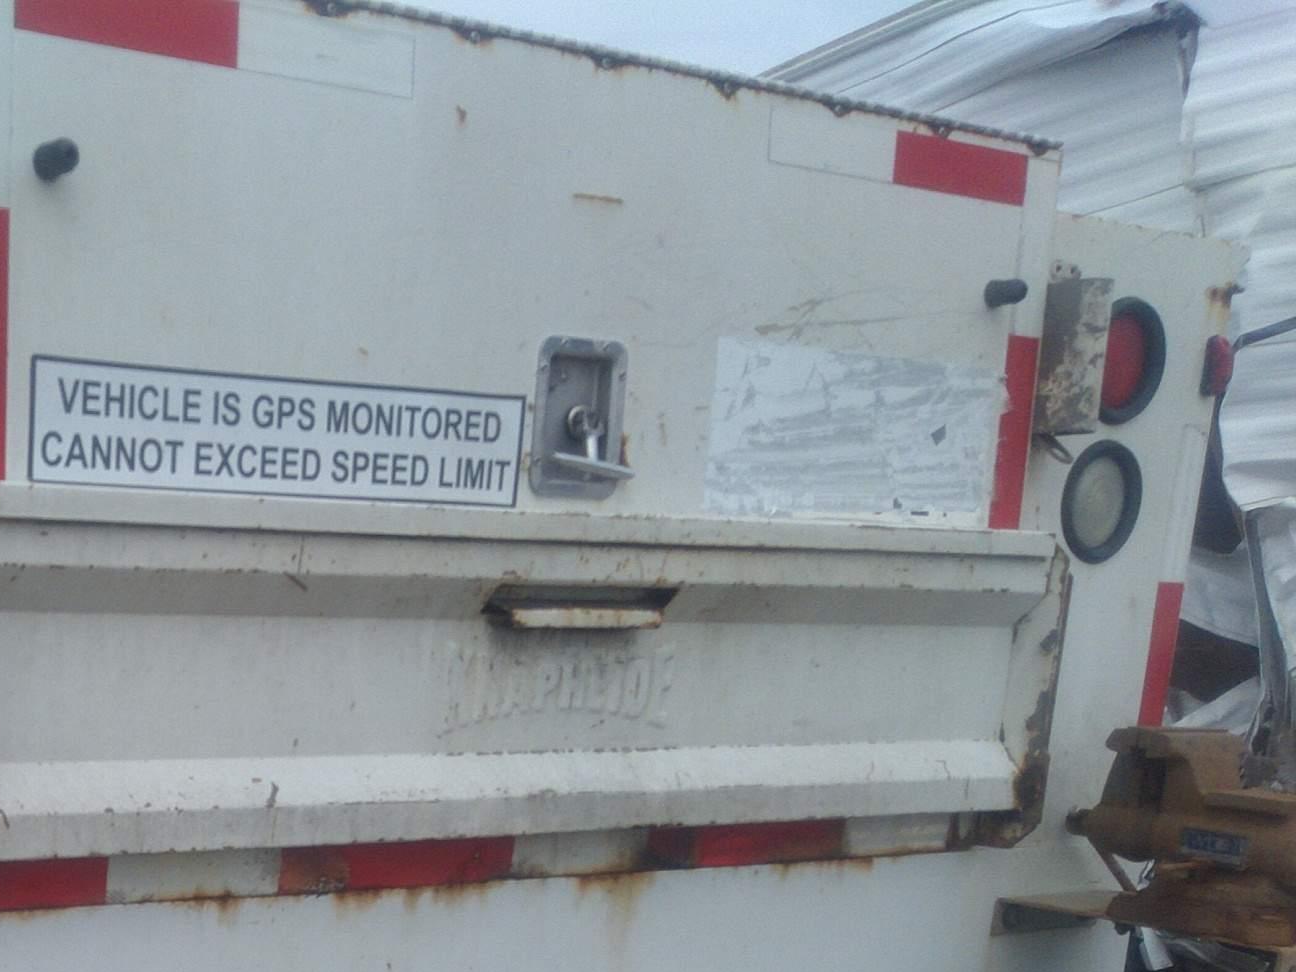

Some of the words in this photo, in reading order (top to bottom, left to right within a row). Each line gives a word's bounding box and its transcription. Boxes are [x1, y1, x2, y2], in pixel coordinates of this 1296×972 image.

[57, 377, 202, 425] VEHICLE
[212, 390, 242, 427] IS
[251, 394, 316, 432] GPS
[326, 399, 502, 444] MONITORED
[40, 430, 185, 475] CANNOT
[193, 441, 322, 482] EXCEED
[330, 449, 430, 487] SPEED
[438, 456, 511, 492] LIMIT
